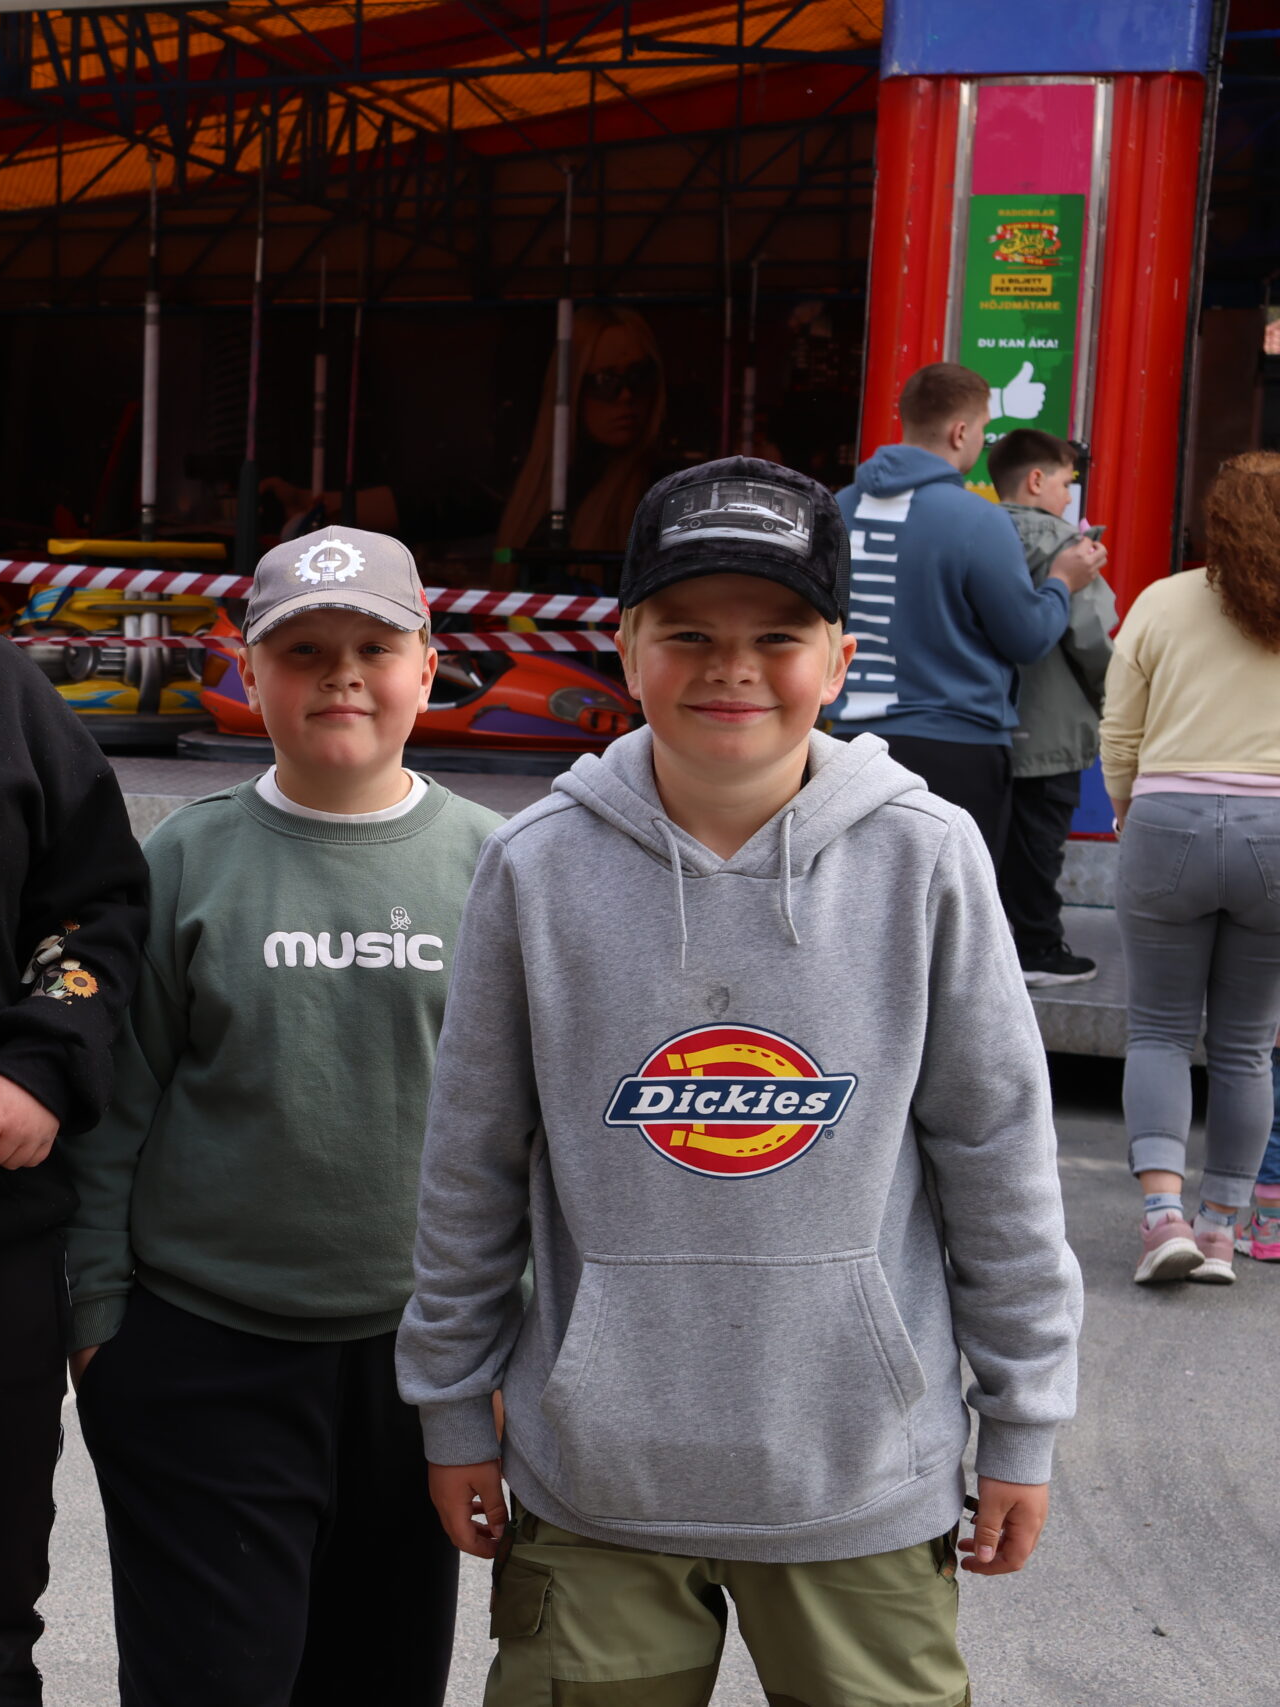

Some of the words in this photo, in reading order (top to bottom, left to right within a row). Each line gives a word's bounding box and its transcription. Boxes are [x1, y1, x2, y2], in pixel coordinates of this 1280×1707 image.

[979, 300, 1061, 311] HÖJDMÄTARE
[977, 338, 996, 348] DU
[998, 338, 1026, 348] KAN
[1028, 336, 1059, 349] ÅKA!
[629, 1084, 832, 1115] Dickies
